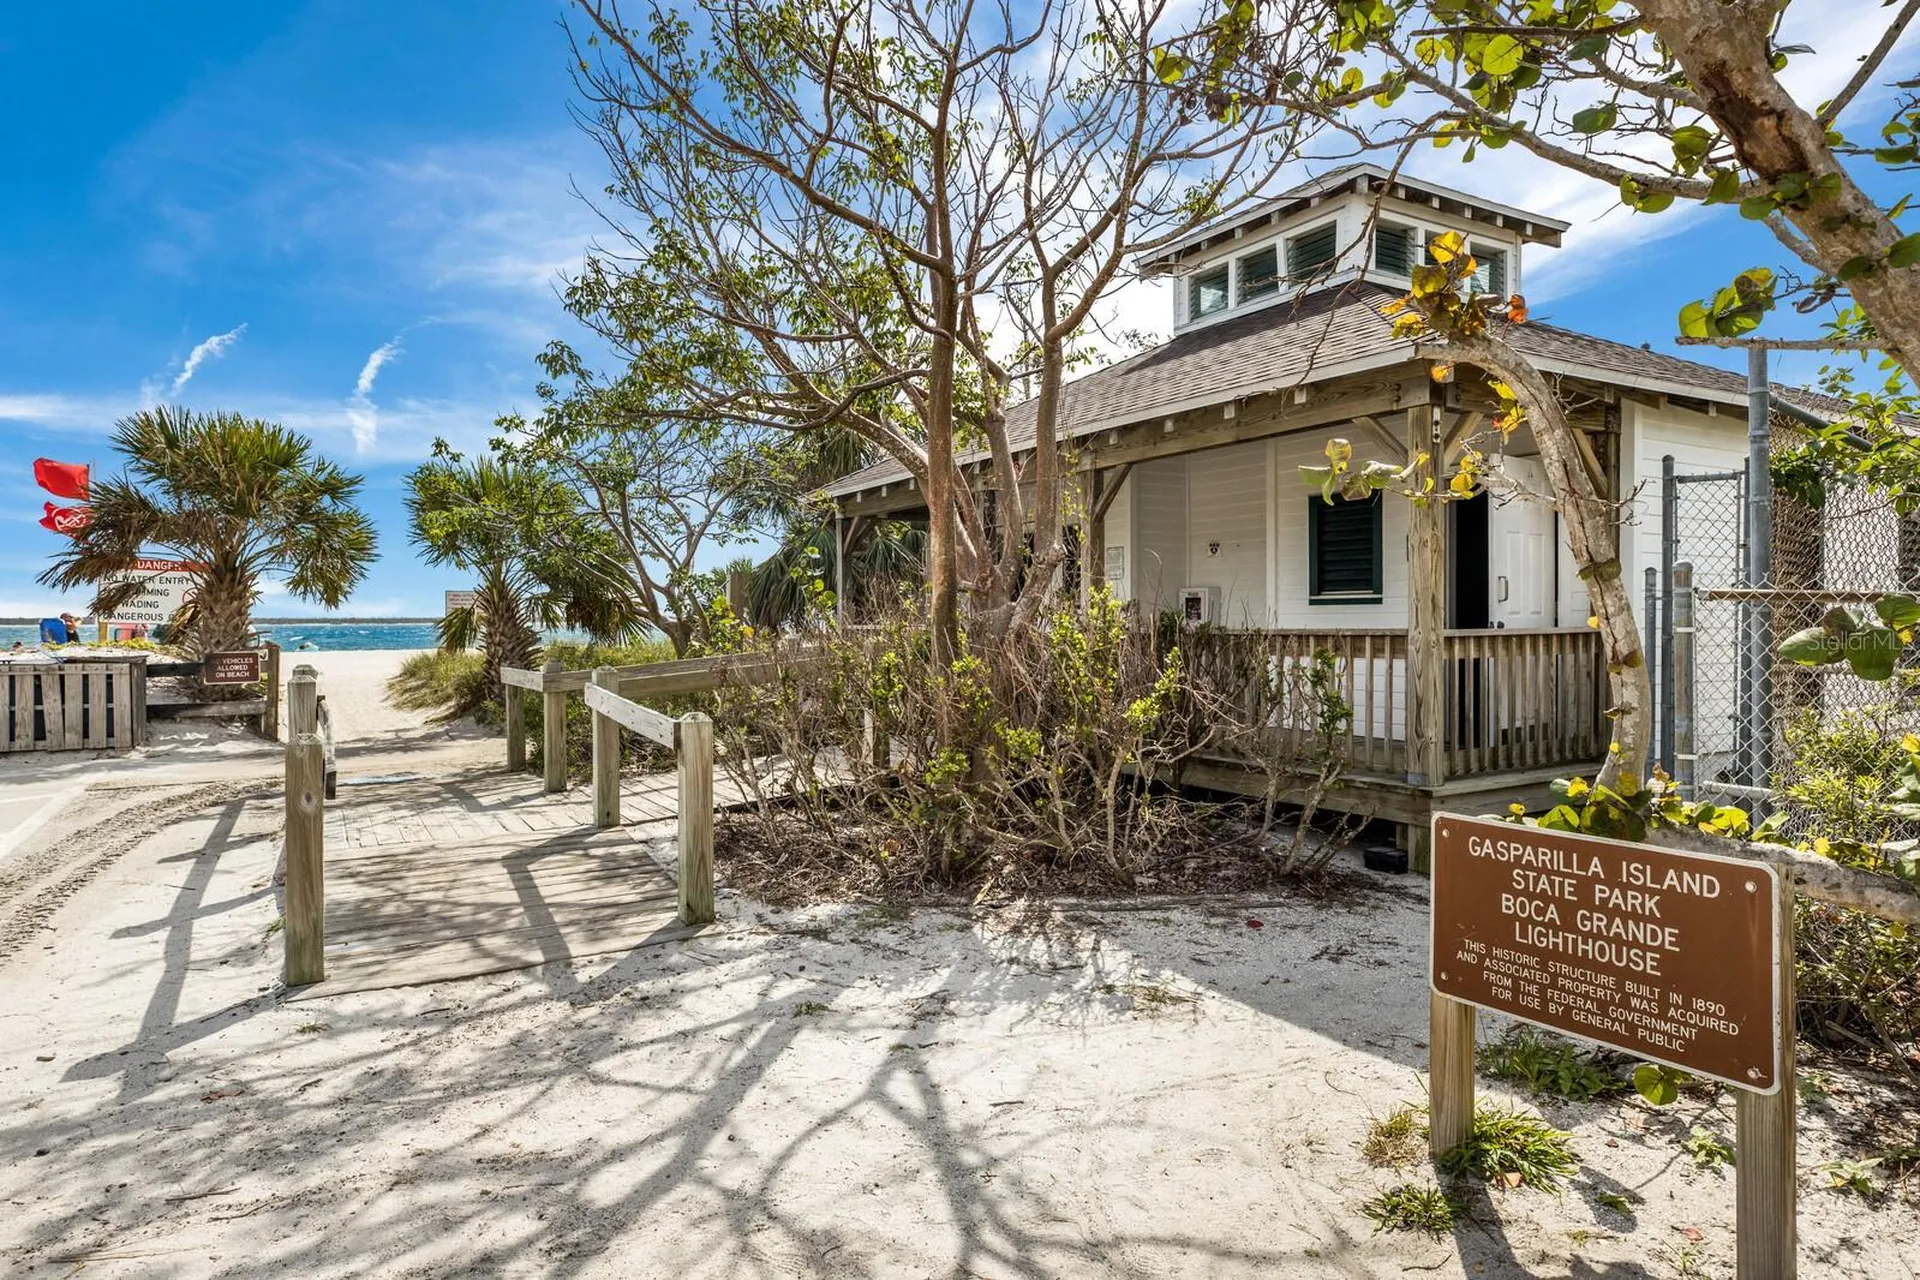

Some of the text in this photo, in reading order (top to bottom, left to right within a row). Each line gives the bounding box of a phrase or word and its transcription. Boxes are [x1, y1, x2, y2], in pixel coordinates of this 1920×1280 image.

[121, 601, 160, 609] WADING
[122, 574, 155, 583] WATER
[159, 577, 190, 585] ENTRY
[1468, 836, 1721, 899] GASPARILLA ISLAND
[1512, 869, 1661, 918] STATE PARK
[1501, 894, 1680, 952] BOCA GRANDE
[1515, 922, 1662, 976] LIGHTHOUSE
[1456, 951, 1739, 1036] AND ASSOCIATED PROPERTY WAS ACQUIRED
[1464, 938, 1726, 1017] THIS HISTORIC STRUCTURE BUILT IN 1890
[1483, 971, 1698, 1040] FROM THE FEDERAL GOVERNMENT
[1491, 986, 1686, 1053] FOR USE BY GENERAL PUBLIC
